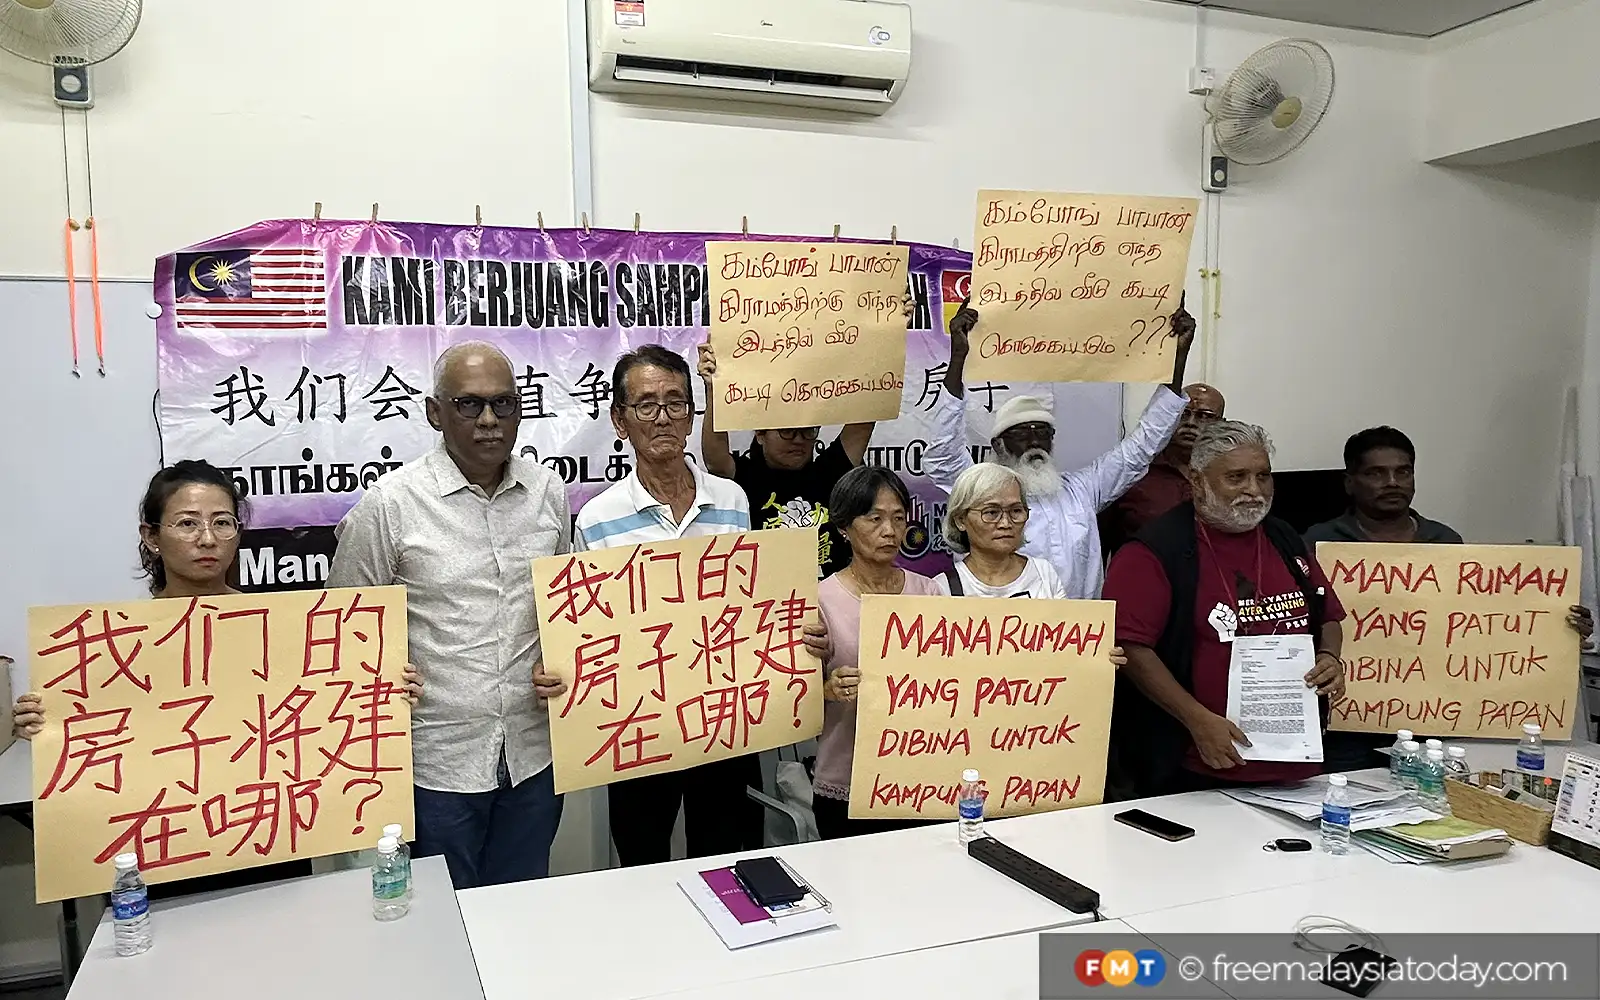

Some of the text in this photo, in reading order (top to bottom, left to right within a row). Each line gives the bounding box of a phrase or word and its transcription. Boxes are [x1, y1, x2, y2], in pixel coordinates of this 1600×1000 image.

[341, 256, 435, 326] KAMI
[444, 259, 610, 328] BERJUANG
[547, 535, 760, 624] 我们的
[1331, 558, 1441, 595] MANA
[1457, 561, 1568, 597] RUMAH
[1266, 598, 1305, 613] KUNING
[1350, 606, 1550, 648] YANG PATUT
[37, 591, 386, 697] 我们的
[560, 589, 817, 718] 房子将建
[880, 611, 1106, 660] MANA RUMAH
[1445, 645, 1548, 682] UNTUK
[886, 673, 1067, 718] YANG PATUT
[1328, 696, 1462, 731] KAMPUNG
[1477, 698, 1566, 732] PAPAN
[39, 676, 406, 801] 房子将建
[877, 714, 1081, 758] DIBINA UNTUK
[869, 773, 1081, 813] KAMPUNG PAPAN
